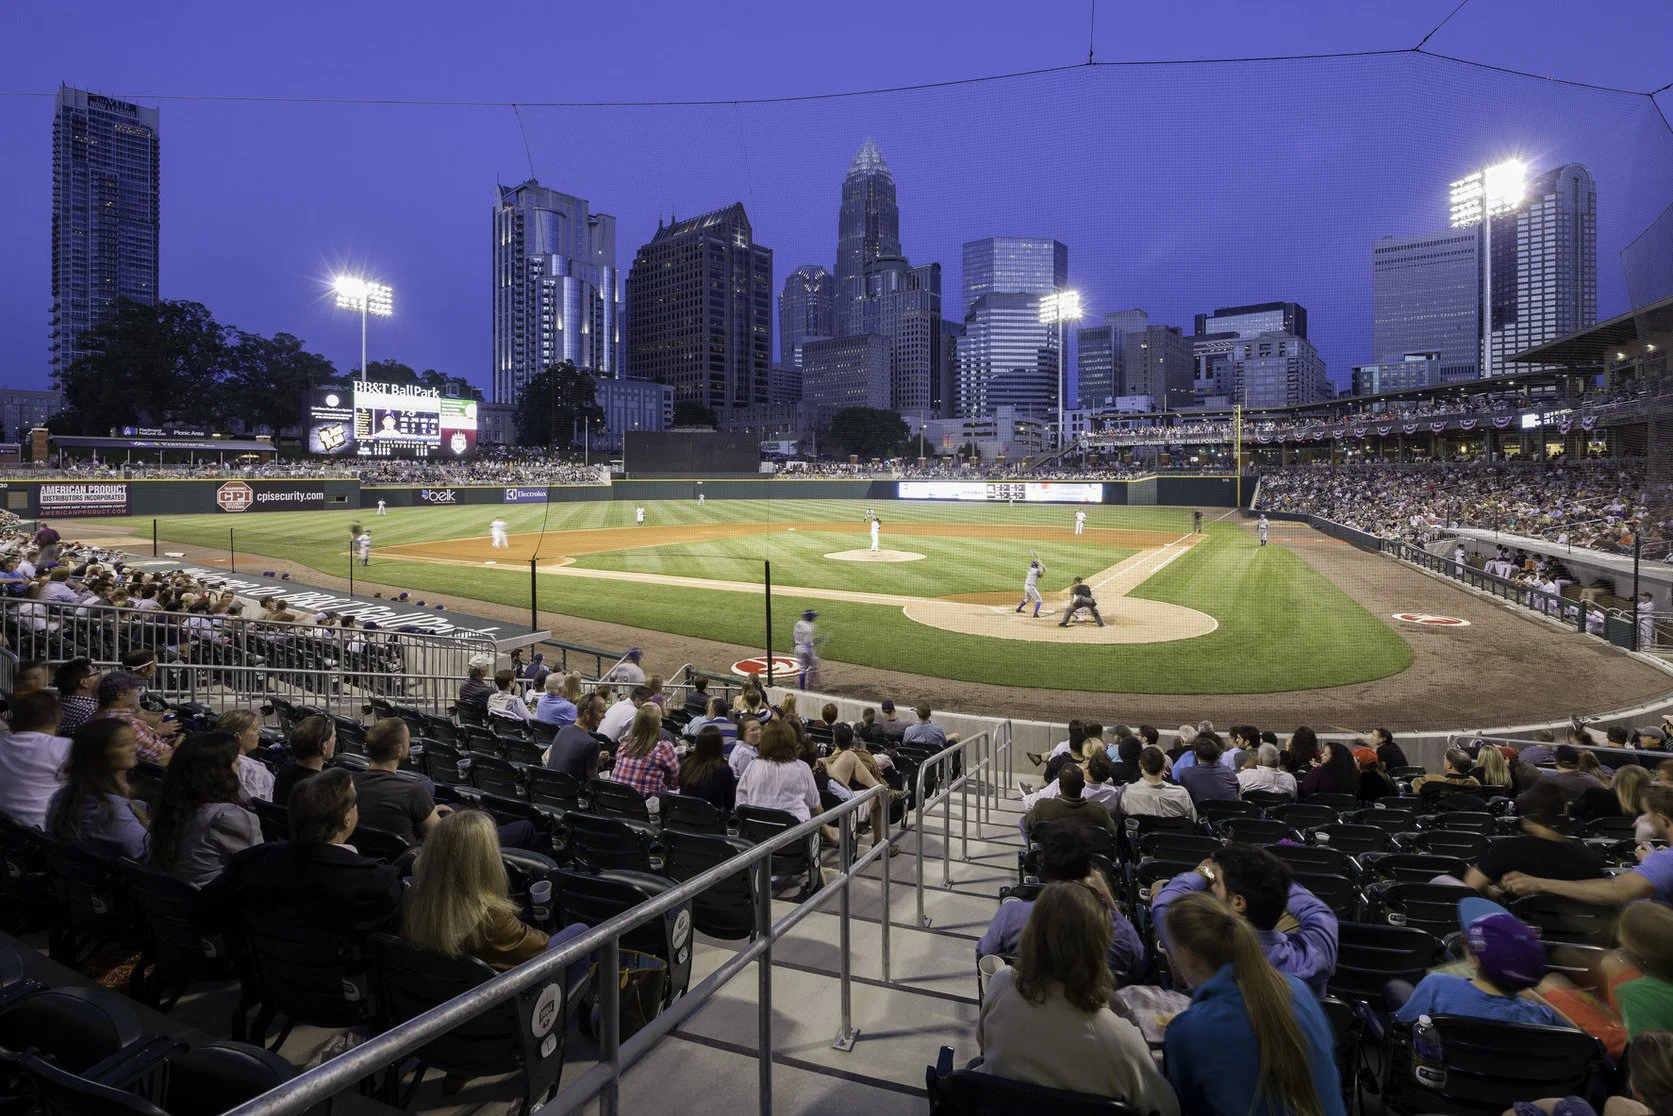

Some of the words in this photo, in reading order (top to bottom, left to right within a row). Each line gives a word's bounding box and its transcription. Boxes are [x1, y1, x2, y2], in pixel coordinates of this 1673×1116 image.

[90, 101, 106, 110] NOW
[107, 105, 136, 118] LEASING
[108, 99, 129, 110] VUE
[353, 381, 389, 395] BB&T
[391, 383, 440, 399] BallPark
[40, 485, 87, 495] AMERICAN
[88, 484, 127, 494] PRODUCT
[517, 490, 547, 498] Electrolux
[42, 494, 83, 502] DISTRIBUTORS
[220, 491, 251, 502] CPI
[256, 491, 324, 503] cpisecurity.com
[428, 489, 456, 502] belk
